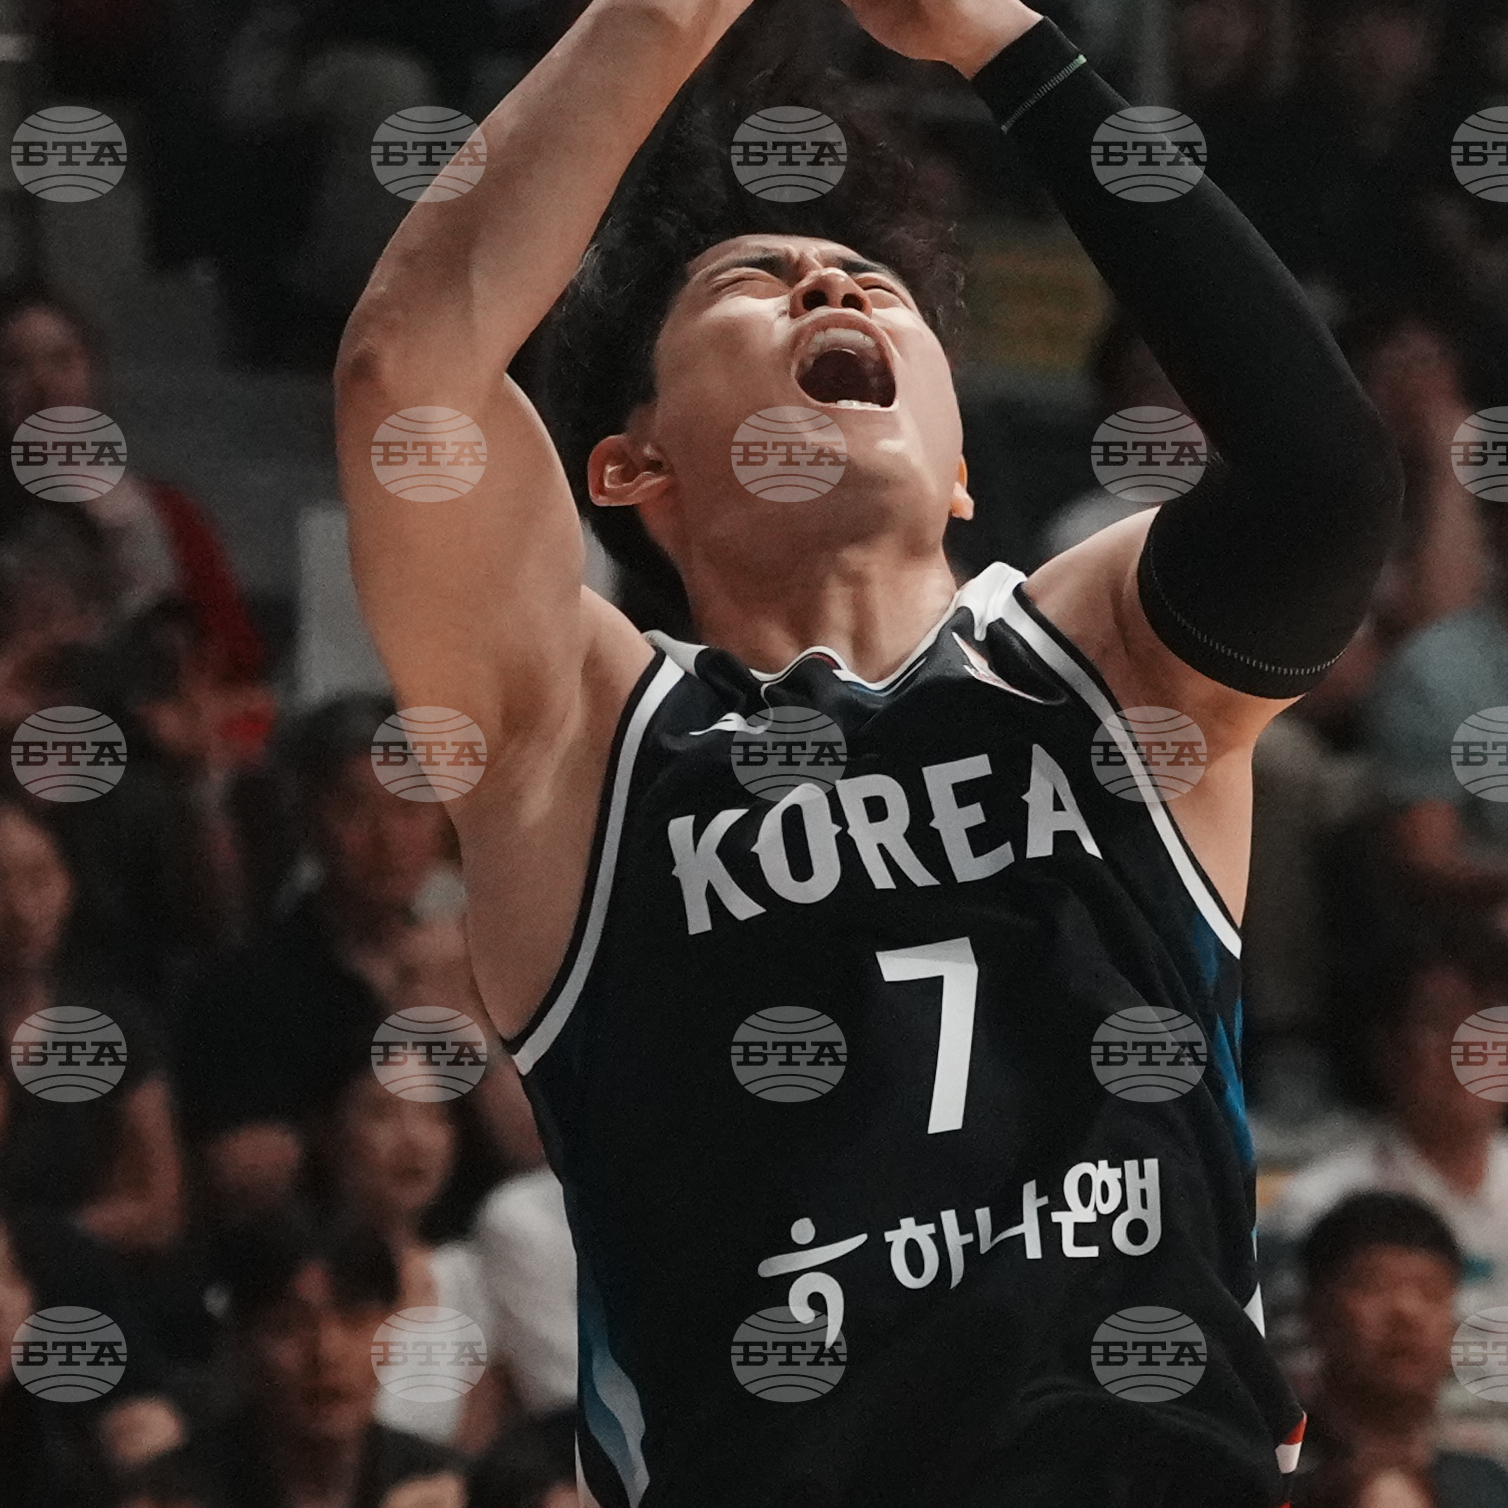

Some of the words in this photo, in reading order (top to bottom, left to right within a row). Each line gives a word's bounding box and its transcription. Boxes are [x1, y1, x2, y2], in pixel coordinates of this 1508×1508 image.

[666, 743, 1103, 936] KOREA
[875, 937, 979, 1134] 7
[884, 1158, 1162, 1289] 하나은행
